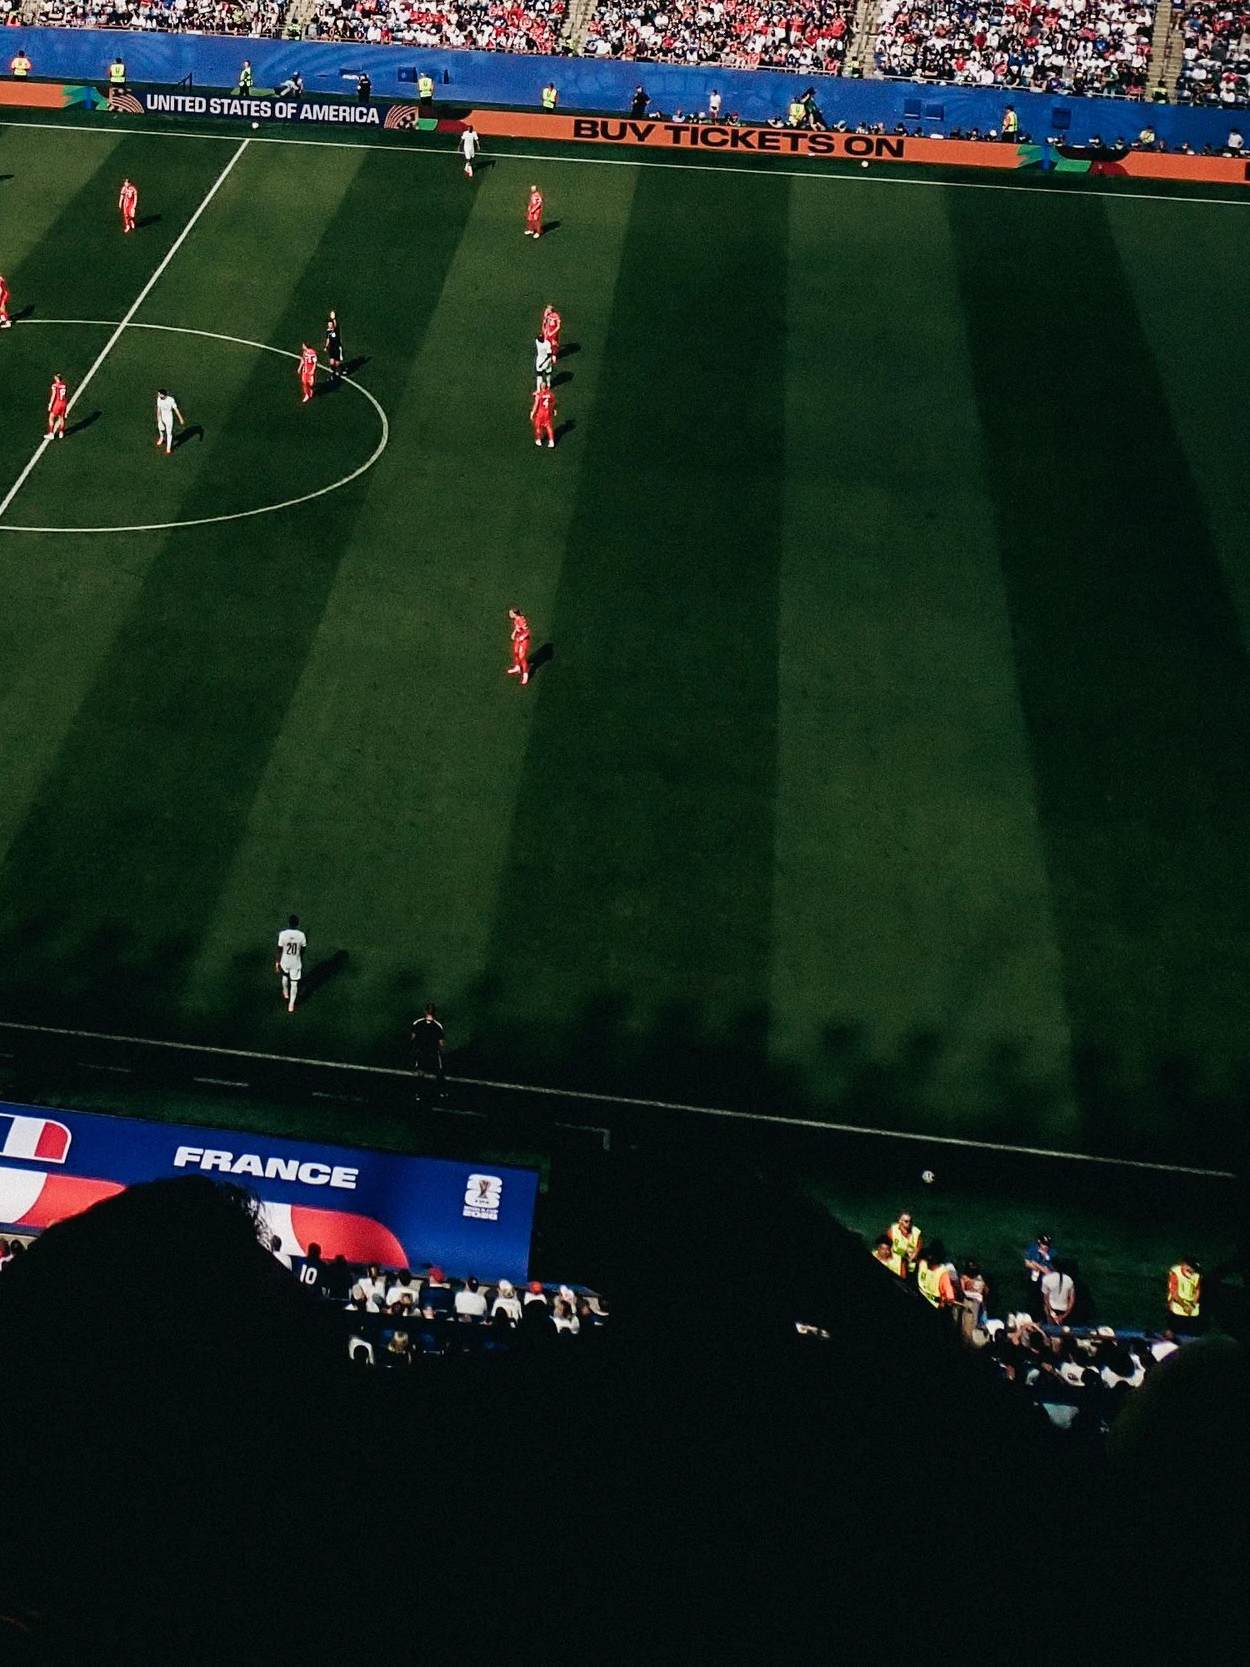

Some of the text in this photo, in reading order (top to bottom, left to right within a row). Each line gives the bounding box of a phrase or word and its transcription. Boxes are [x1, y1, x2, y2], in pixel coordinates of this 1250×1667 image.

[146, 94, 381, 125] UNITED STATES OF AMERICA
[573, 118, 905, 159] BUY TICKETS ON
[286, 942, 298, 956] 20
[173, 1145, 360, 1190] FRANCE
[299, 1263, 318, 1286] 10
